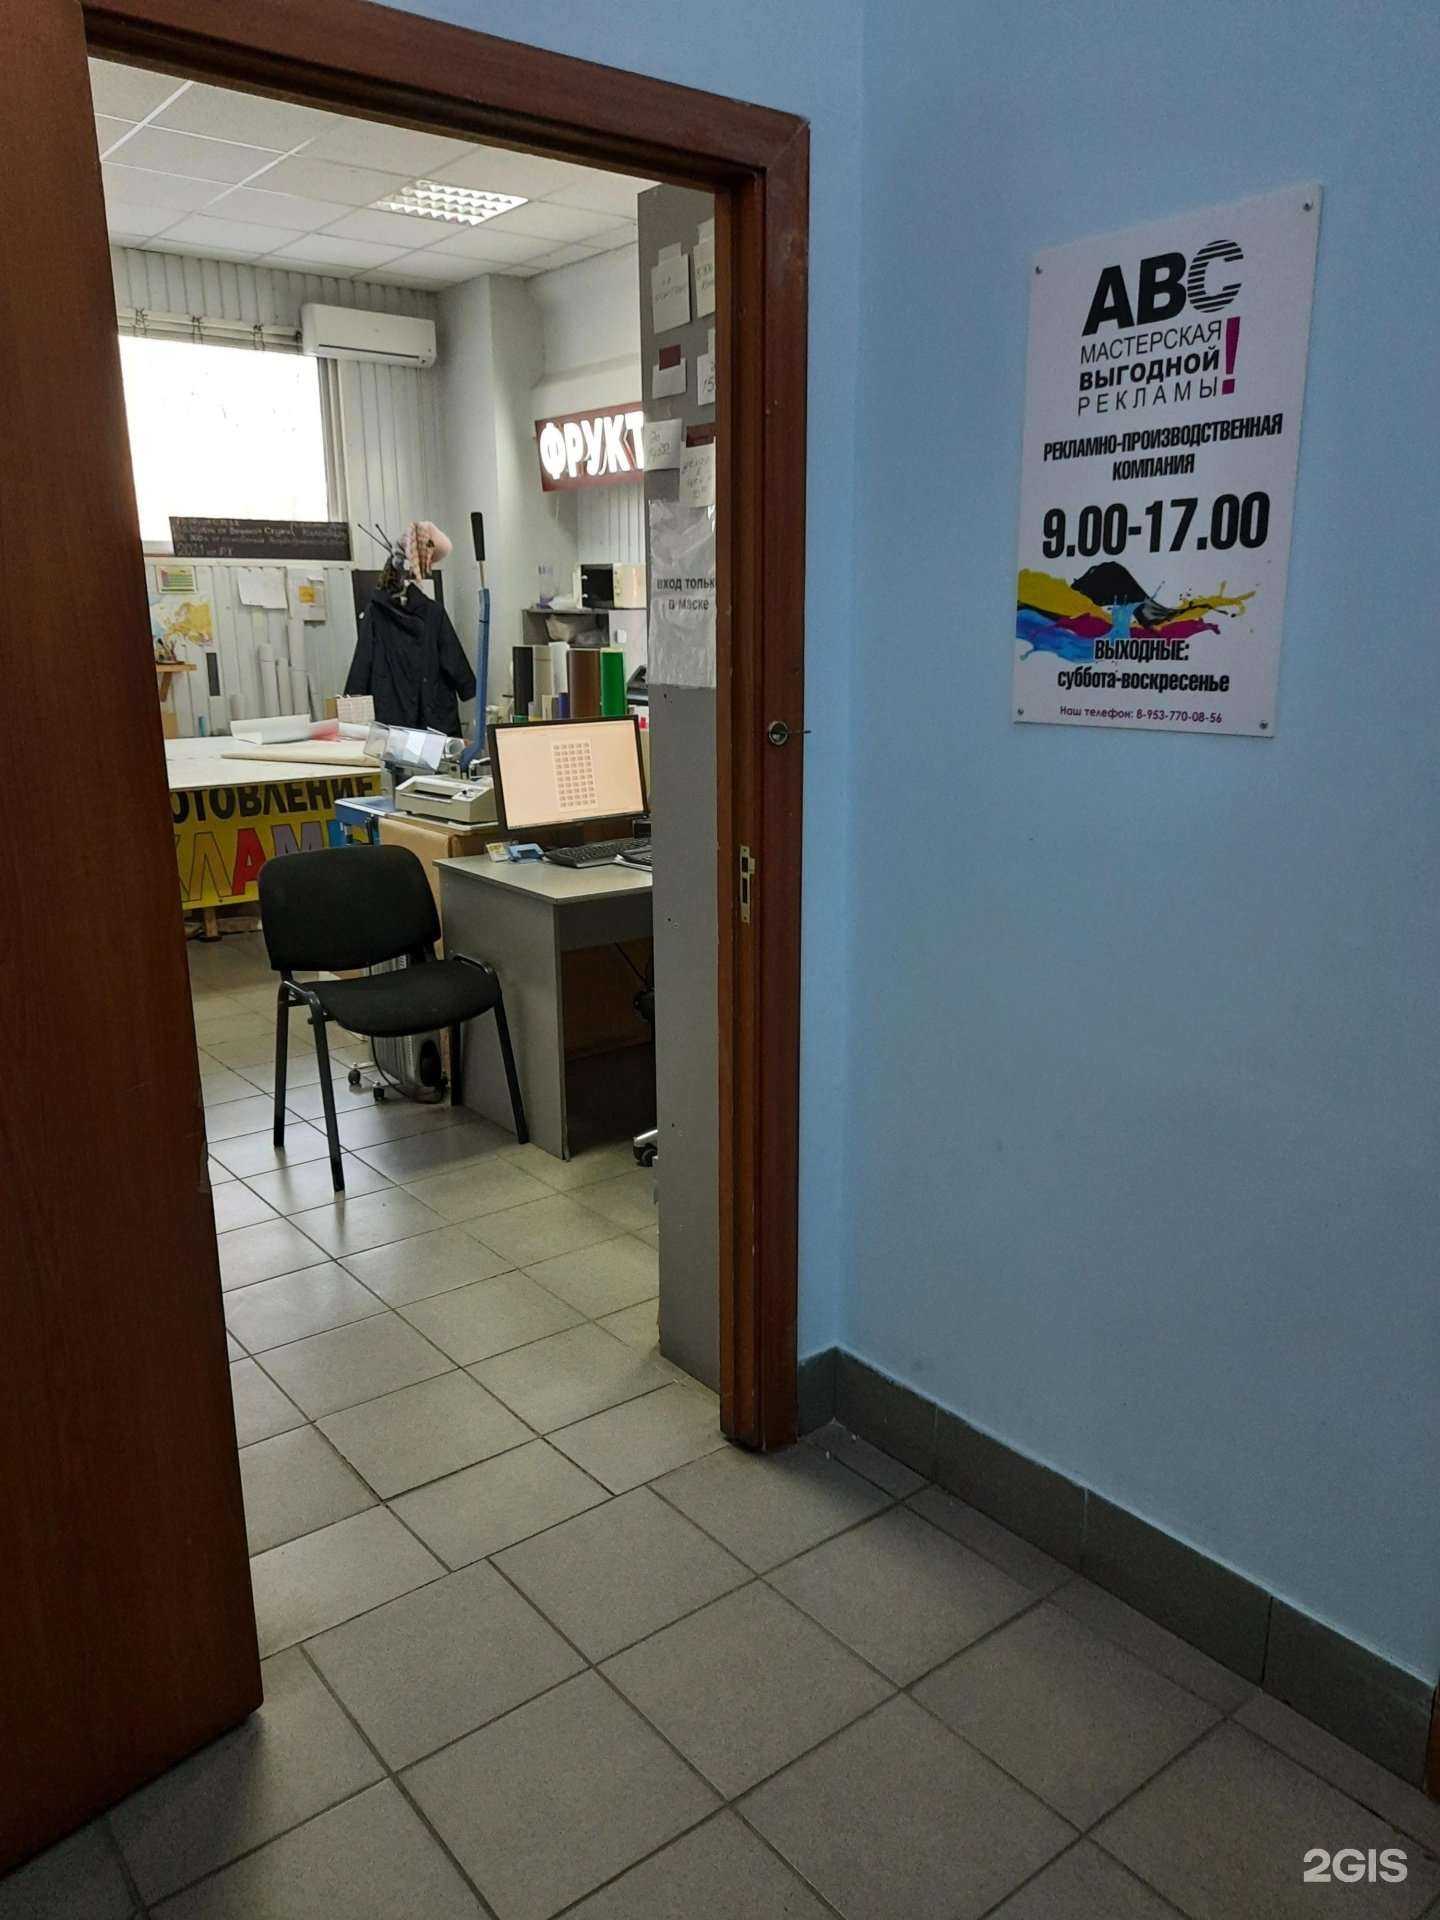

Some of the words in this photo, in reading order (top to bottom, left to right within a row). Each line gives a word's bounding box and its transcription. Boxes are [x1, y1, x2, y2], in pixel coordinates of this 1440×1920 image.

[1080, 319, 1222, 364] МАСТЕРСКАЯ
[1078, 345, 1220, 391] ВЫГОДНОЙ
[1043, 413, 1284, 462] РЕКЛАМНО-ПРОИЗВОДСТВЕННАЯ
[1112, 453, 1196, 481] КОМПАНИЯ
[1042, 491, 1271, 559] 9.00-17.00
[1094, 639, 1190, 663] ВЫХОДНЫЕ:
[1057, 666, 1230, 693] суббота-воскресенье
[1060, 705, 1080, 717] Наш
[1084, 707, 1134, 721] телефон:
